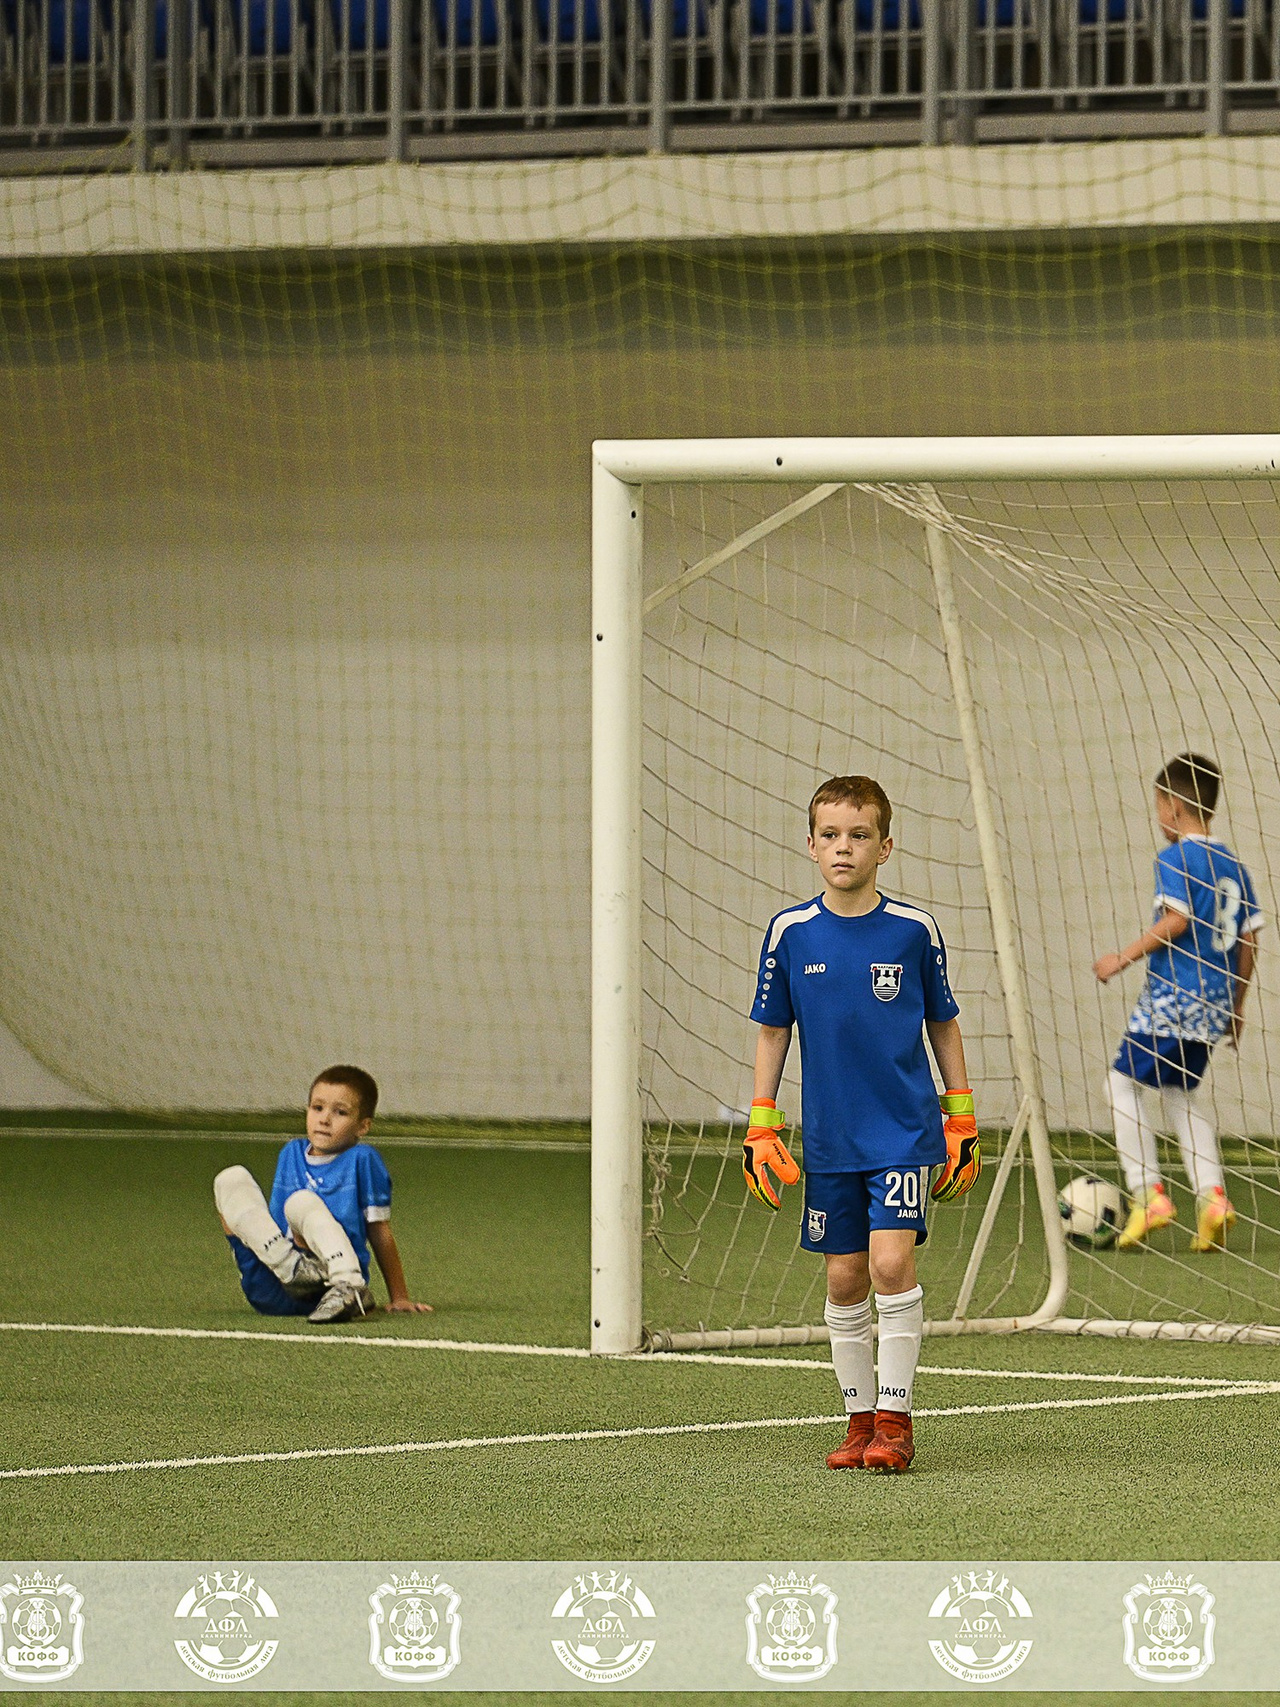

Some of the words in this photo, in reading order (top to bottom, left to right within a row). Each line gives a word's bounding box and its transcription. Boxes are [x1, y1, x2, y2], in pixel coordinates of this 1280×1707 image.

[804, 963, 826, 975] JAKO
[884, 1171, 919, 1208] 20
[897, 1208, 918, 1219] JAKO
[878, 1385, 907, 1399] JAKO
